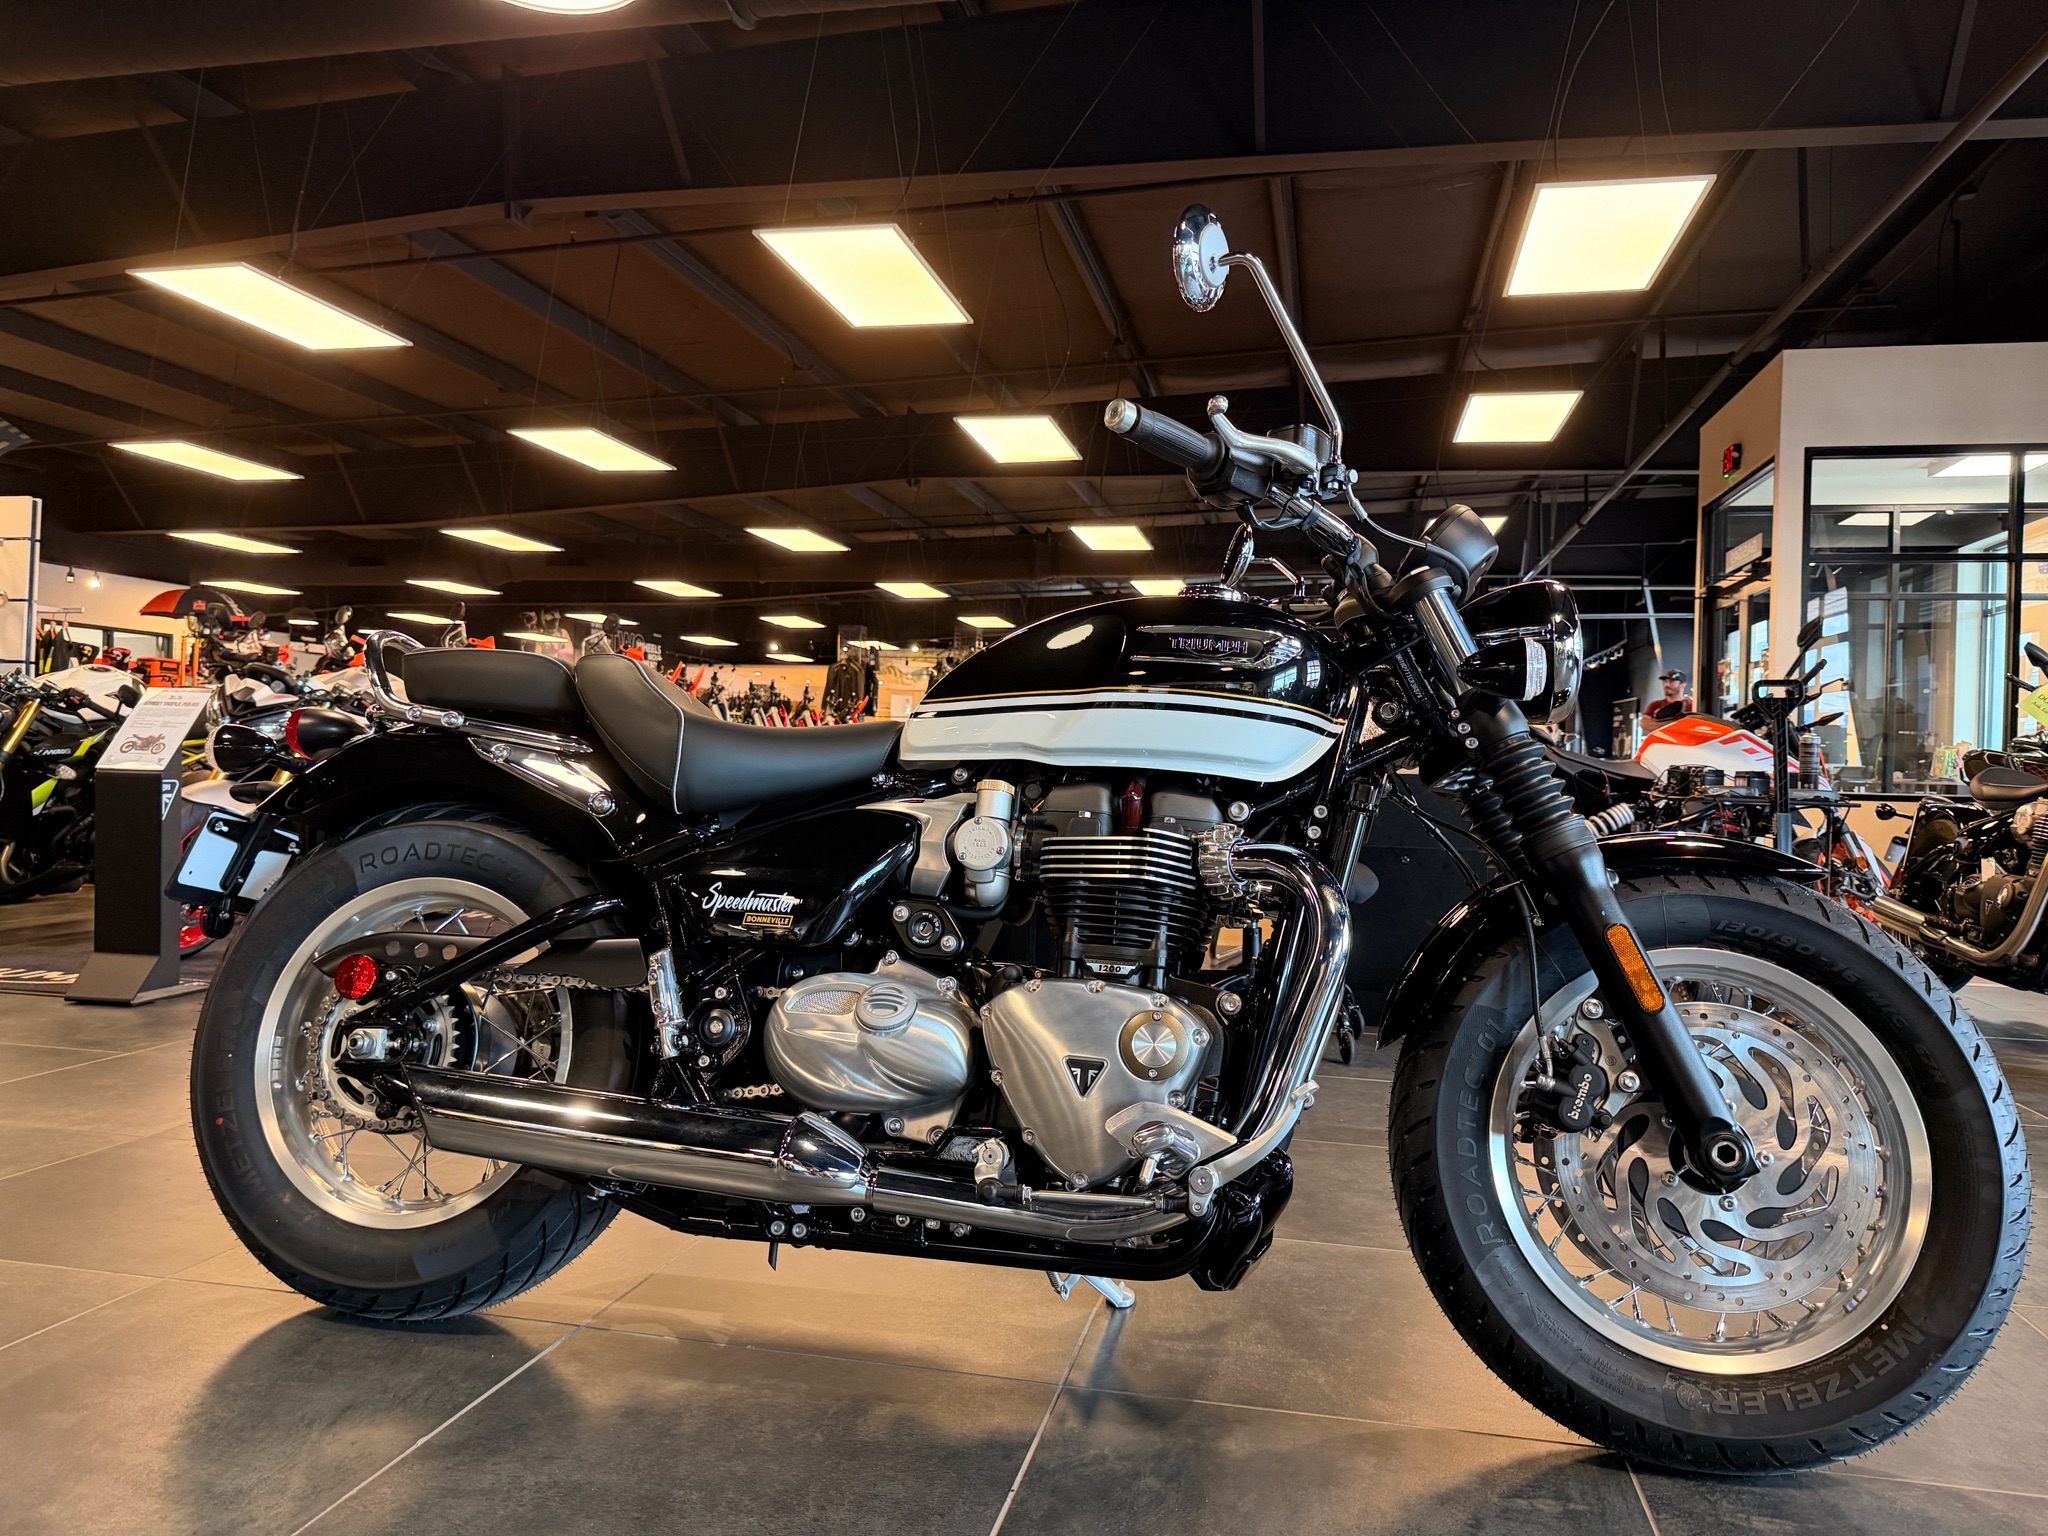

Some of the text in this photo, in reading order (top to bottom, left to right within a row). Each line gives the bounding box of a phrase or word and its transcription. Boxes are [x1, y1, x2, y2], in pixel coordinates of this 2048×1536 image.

[1169, 637, 1248, 656] TRIUMPH
[359, 841, 494, 873] ROADTEC
[702, 881, 795, 917] Speedmaster
[746, 915, 790, 925] BONNEVILLE
[1715, 919, 1816, 955] 130/90
[1098, 965, 1122, 973] 1200
[1567, 1073, 1593, 1120] brembo
[1457, 1018, 1506, 1246] ROADTEC 01
[1708, 1324, 1926, 1416] METZELER
